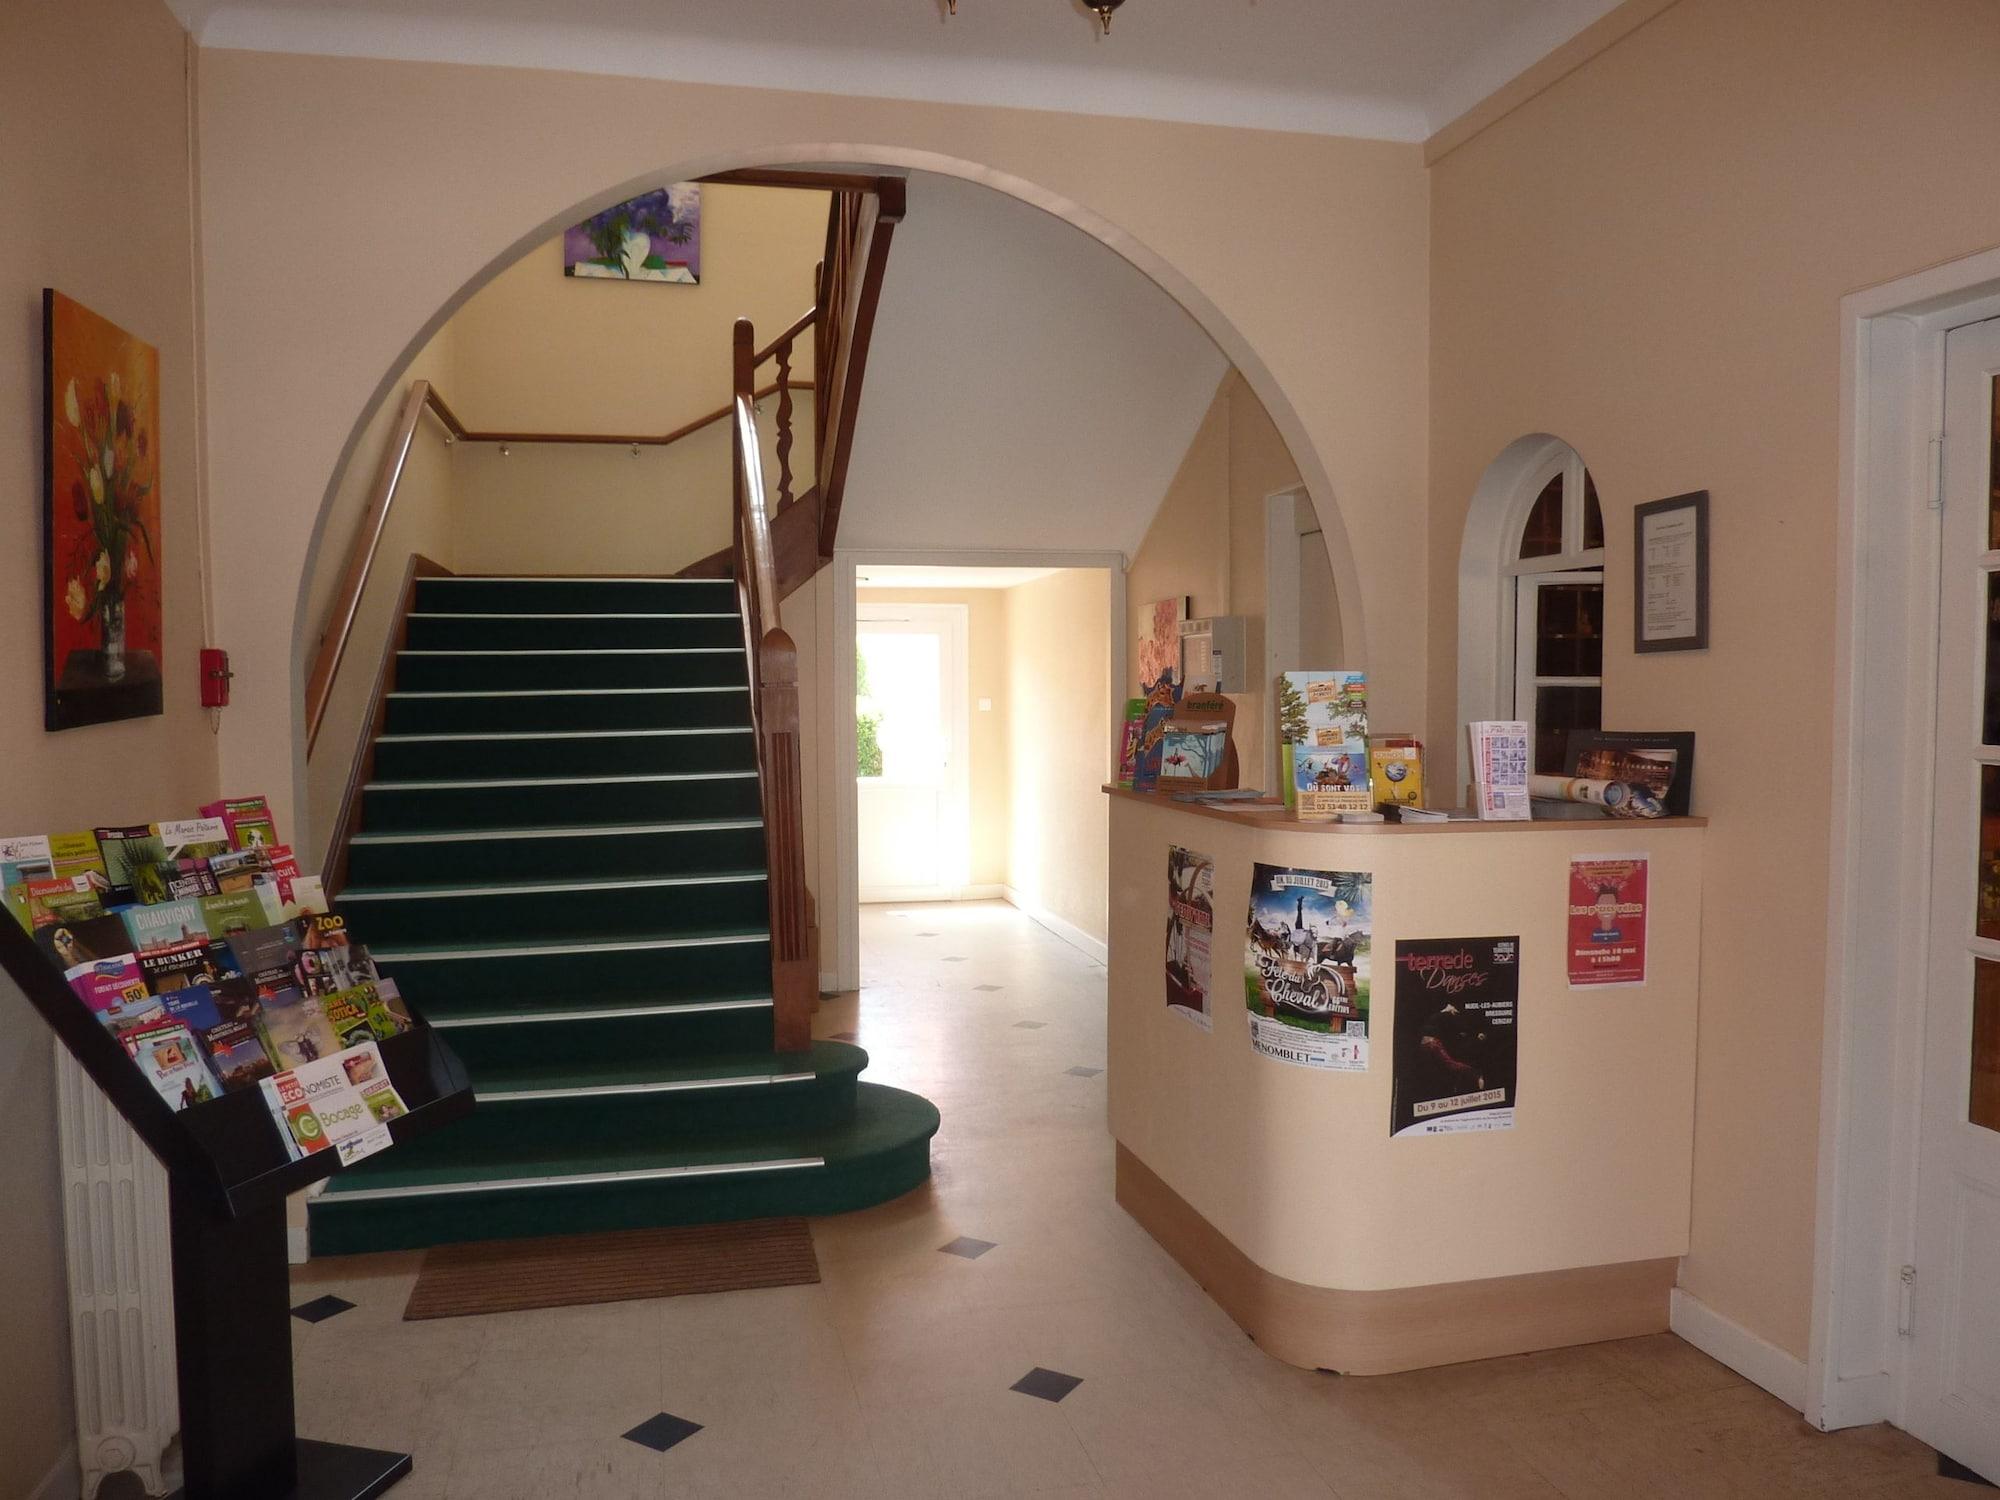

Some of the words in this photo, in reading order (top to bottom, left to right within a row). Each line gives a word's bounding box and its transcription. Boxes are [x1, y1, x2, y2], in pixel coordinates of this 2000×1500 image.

[1293, 876, 1313, 887] JUILLET
[135, 904, 196, 929] CHAUVIGNY
[316, 914, 344, 931] ZOO
[143, 958, 154, 969] LE
[157, 948, 203, 967] BUNKER
[1575, 948, 1611, 956] Dimanche
[1265, 979, 1321, 1009] Cheval
[1253, 1040, 1312, 1063] MENOMBLET
[281, 1075, 341, 1102] ECONOMISTE
[1417, 1103, 1429, 1113] Du
[1431, 1102, 1436, 1110] 9
[1460, 1095, 1481, 1107] juillet
[1484, 1090, 1502, 1100] 2015
[319, 1103, 364, 1127] Bocage
